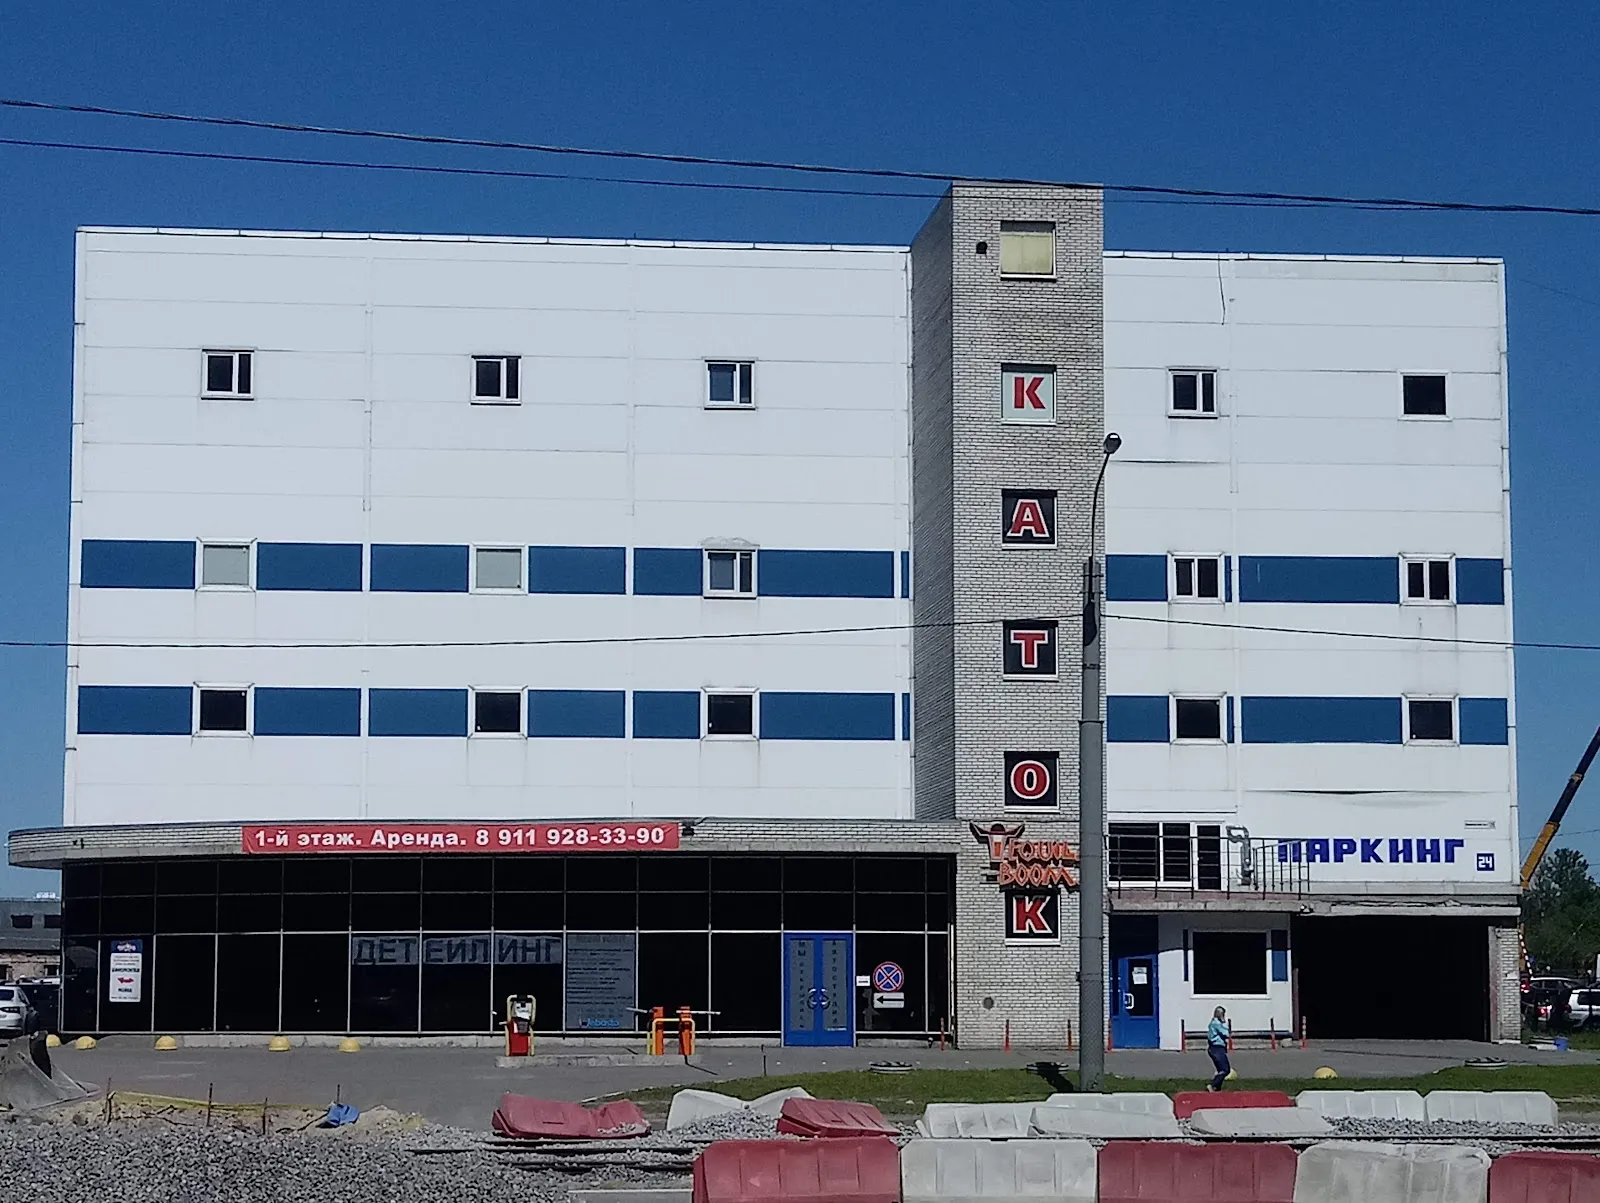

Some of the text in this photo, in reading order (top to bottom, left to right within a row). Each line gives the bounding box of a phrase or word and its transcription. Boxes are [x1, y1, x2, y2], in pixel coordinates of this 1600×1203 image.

[255, 827, 665, 849] 1-й этаж. Аренда. 8 911 928-33-90
[1278, 838, 1464, 863] ПАРКИНГ
[1478, 855, 1493, 869] 24
